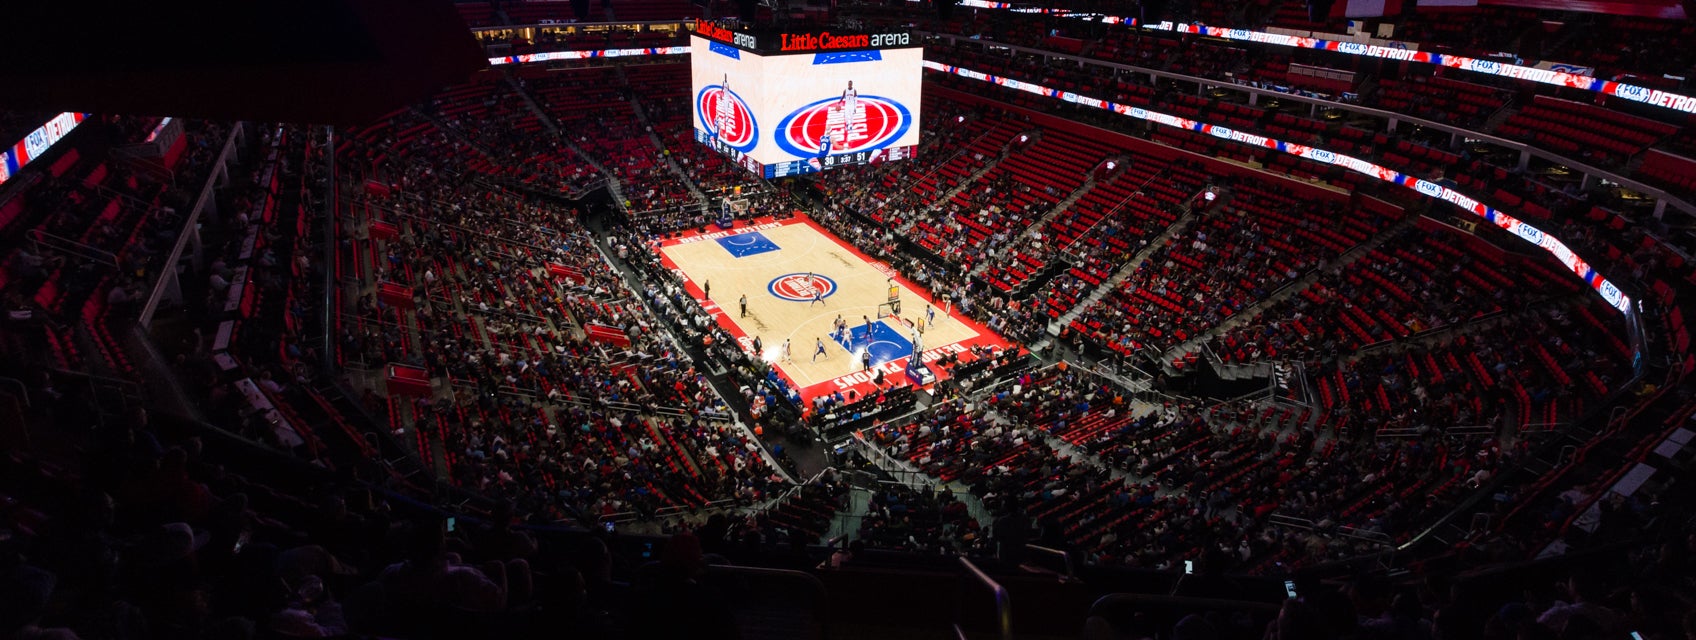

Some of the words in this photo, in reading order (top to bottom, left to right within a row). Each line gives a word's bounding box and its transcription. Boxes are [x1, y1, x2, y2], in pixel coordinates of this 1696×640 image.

[733, 31, 756, 49] arena
[781, 33, 818, 51] Little
[818, 31, 869, 49] Caesars
[871, 32, 909, 47] arena
[1251, 32, 1289, 45] DETROIT
[1344, 42, 1360, 51] FOX
[1366, 45, 1418, 61] DETROIT
[1477, 60, 1494, 70] FOX
[1501, 63, 1556, 85] DETROIT
[1624, 85, 1642, 97] FOX
[30, 131, 44, 147] FOX
[821, 142, 827, 152] 0
[1232, 131, 1267, 147] DETROIT
[825, 156, 834, 166] 30
[857, 152, 866, 161] 51
[1315, 150, 1330, 160] FOX
[1336, 154, 1374, 173] DETROIT
[1421, 181, 1437, 193] FOX
[1442, 187, 1479, 212] DETROIT
[679, 230, 730, 245] DETROIT
[733, 220, 783, 235] PISTONS
[1523, 225, 1538, 239] FOX
[1605, 285, 1617, 298] FOX
